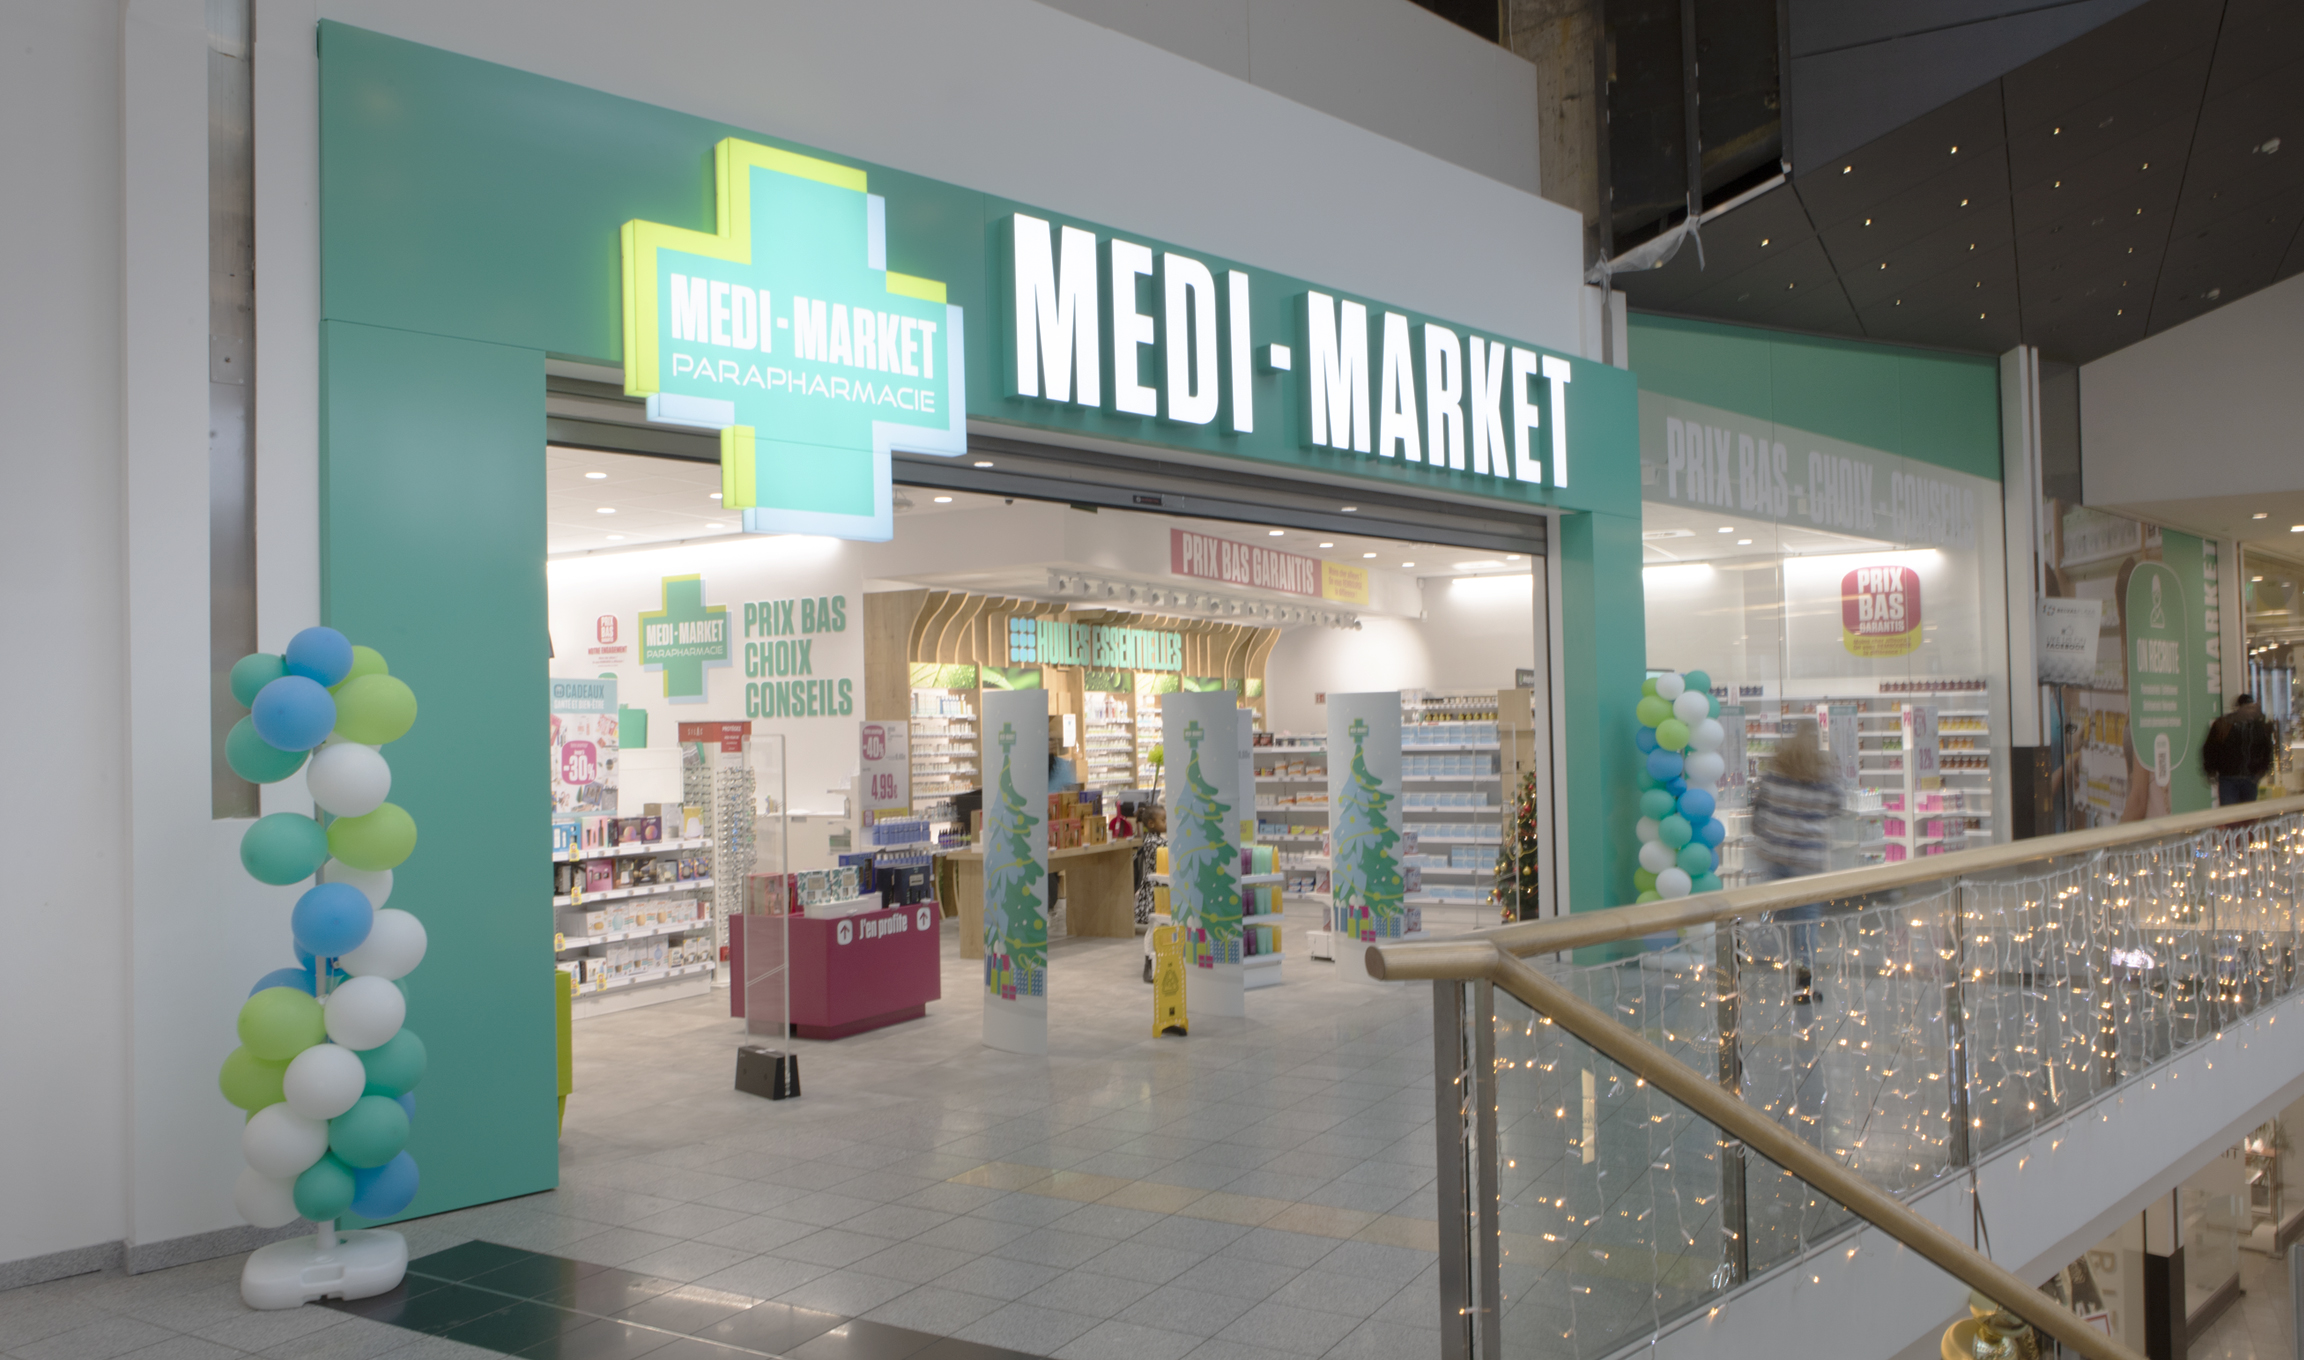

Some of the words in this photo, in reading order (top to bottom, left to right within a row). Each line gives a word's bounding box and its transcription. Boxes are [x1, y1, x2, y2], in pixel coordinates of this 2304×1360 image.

[1013, 212, 1572, 489] MEDI-MARKET
[671, 353, 936, 414] PARAPHARMACIE
[1666, 416, 1733, 509] PRIX
[1739, 433, 1788, 519] BAS
[1807, 450, 1875, 531] CHOIX
[1182, 531, 1218, 577] PRIX
[1221, 538, 1250, 583] BAS
[1251, 543, 1315, 596] GARANTIS
[1856, 567, 1904, 594] PRIX
[744, 598, 795, 638] PRIX
[801, 595, 847, 634] BAS
[1858, 592, 1905, 622] BAS
[1858, 620, 1905, 634] GARANTIS
[645, 645, 724, 659] PARAPHARMACIE
[744, 638, 813, 678] CHOIX
[1036, 618, 1091, 667] HUILES
[1091, 623, 1183, 672] ESSENTIELLES
[565, 683, 605, 699] CADEAUX
[745, 677, 853, 719] CONSEILS
[863, 736, 885, 758] -40%
[563, 755, 595, 782] -30%
[871, 773, 898, 803] 4,99€
[858, 917, 877, 941] J'en
[877, 913, 909, 940] profite
